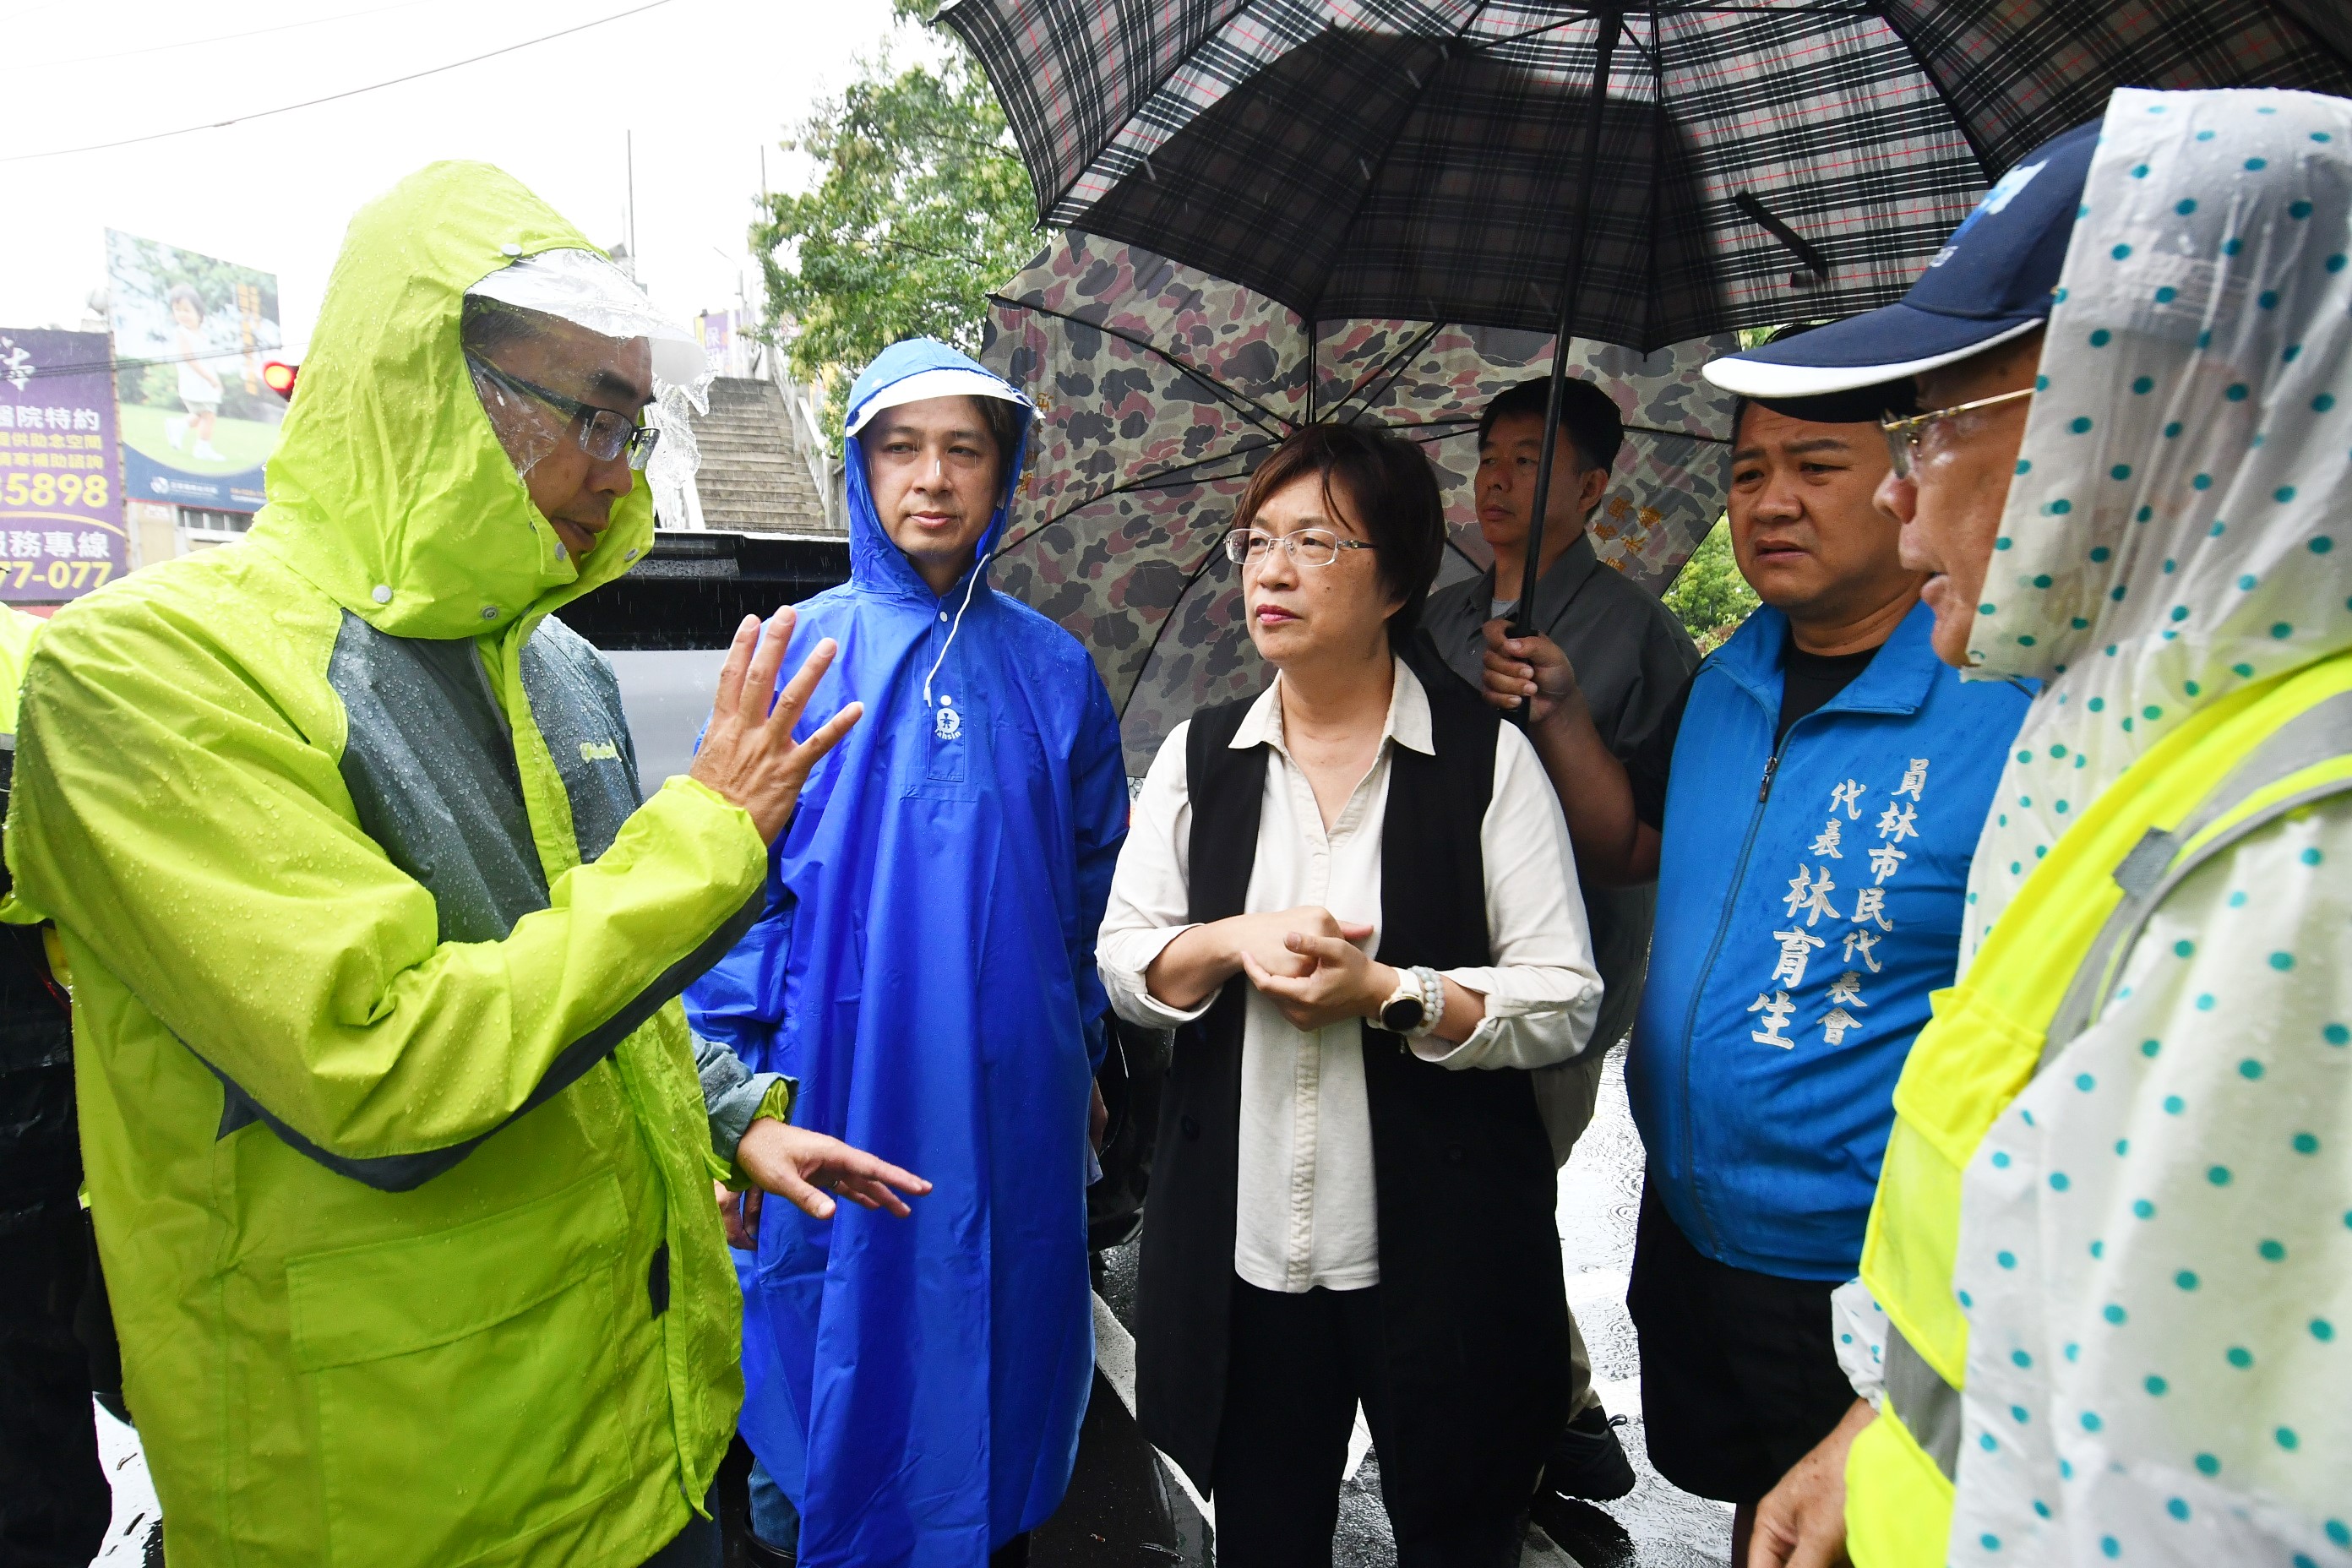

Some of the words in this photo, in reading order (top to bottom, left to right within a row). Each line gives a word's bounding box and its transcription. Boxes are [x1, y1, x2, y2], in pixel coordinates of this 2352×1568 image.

[0, 472, 109, 509] 5898
[1816, 757, 1930, 1047] 員林市民代表會
